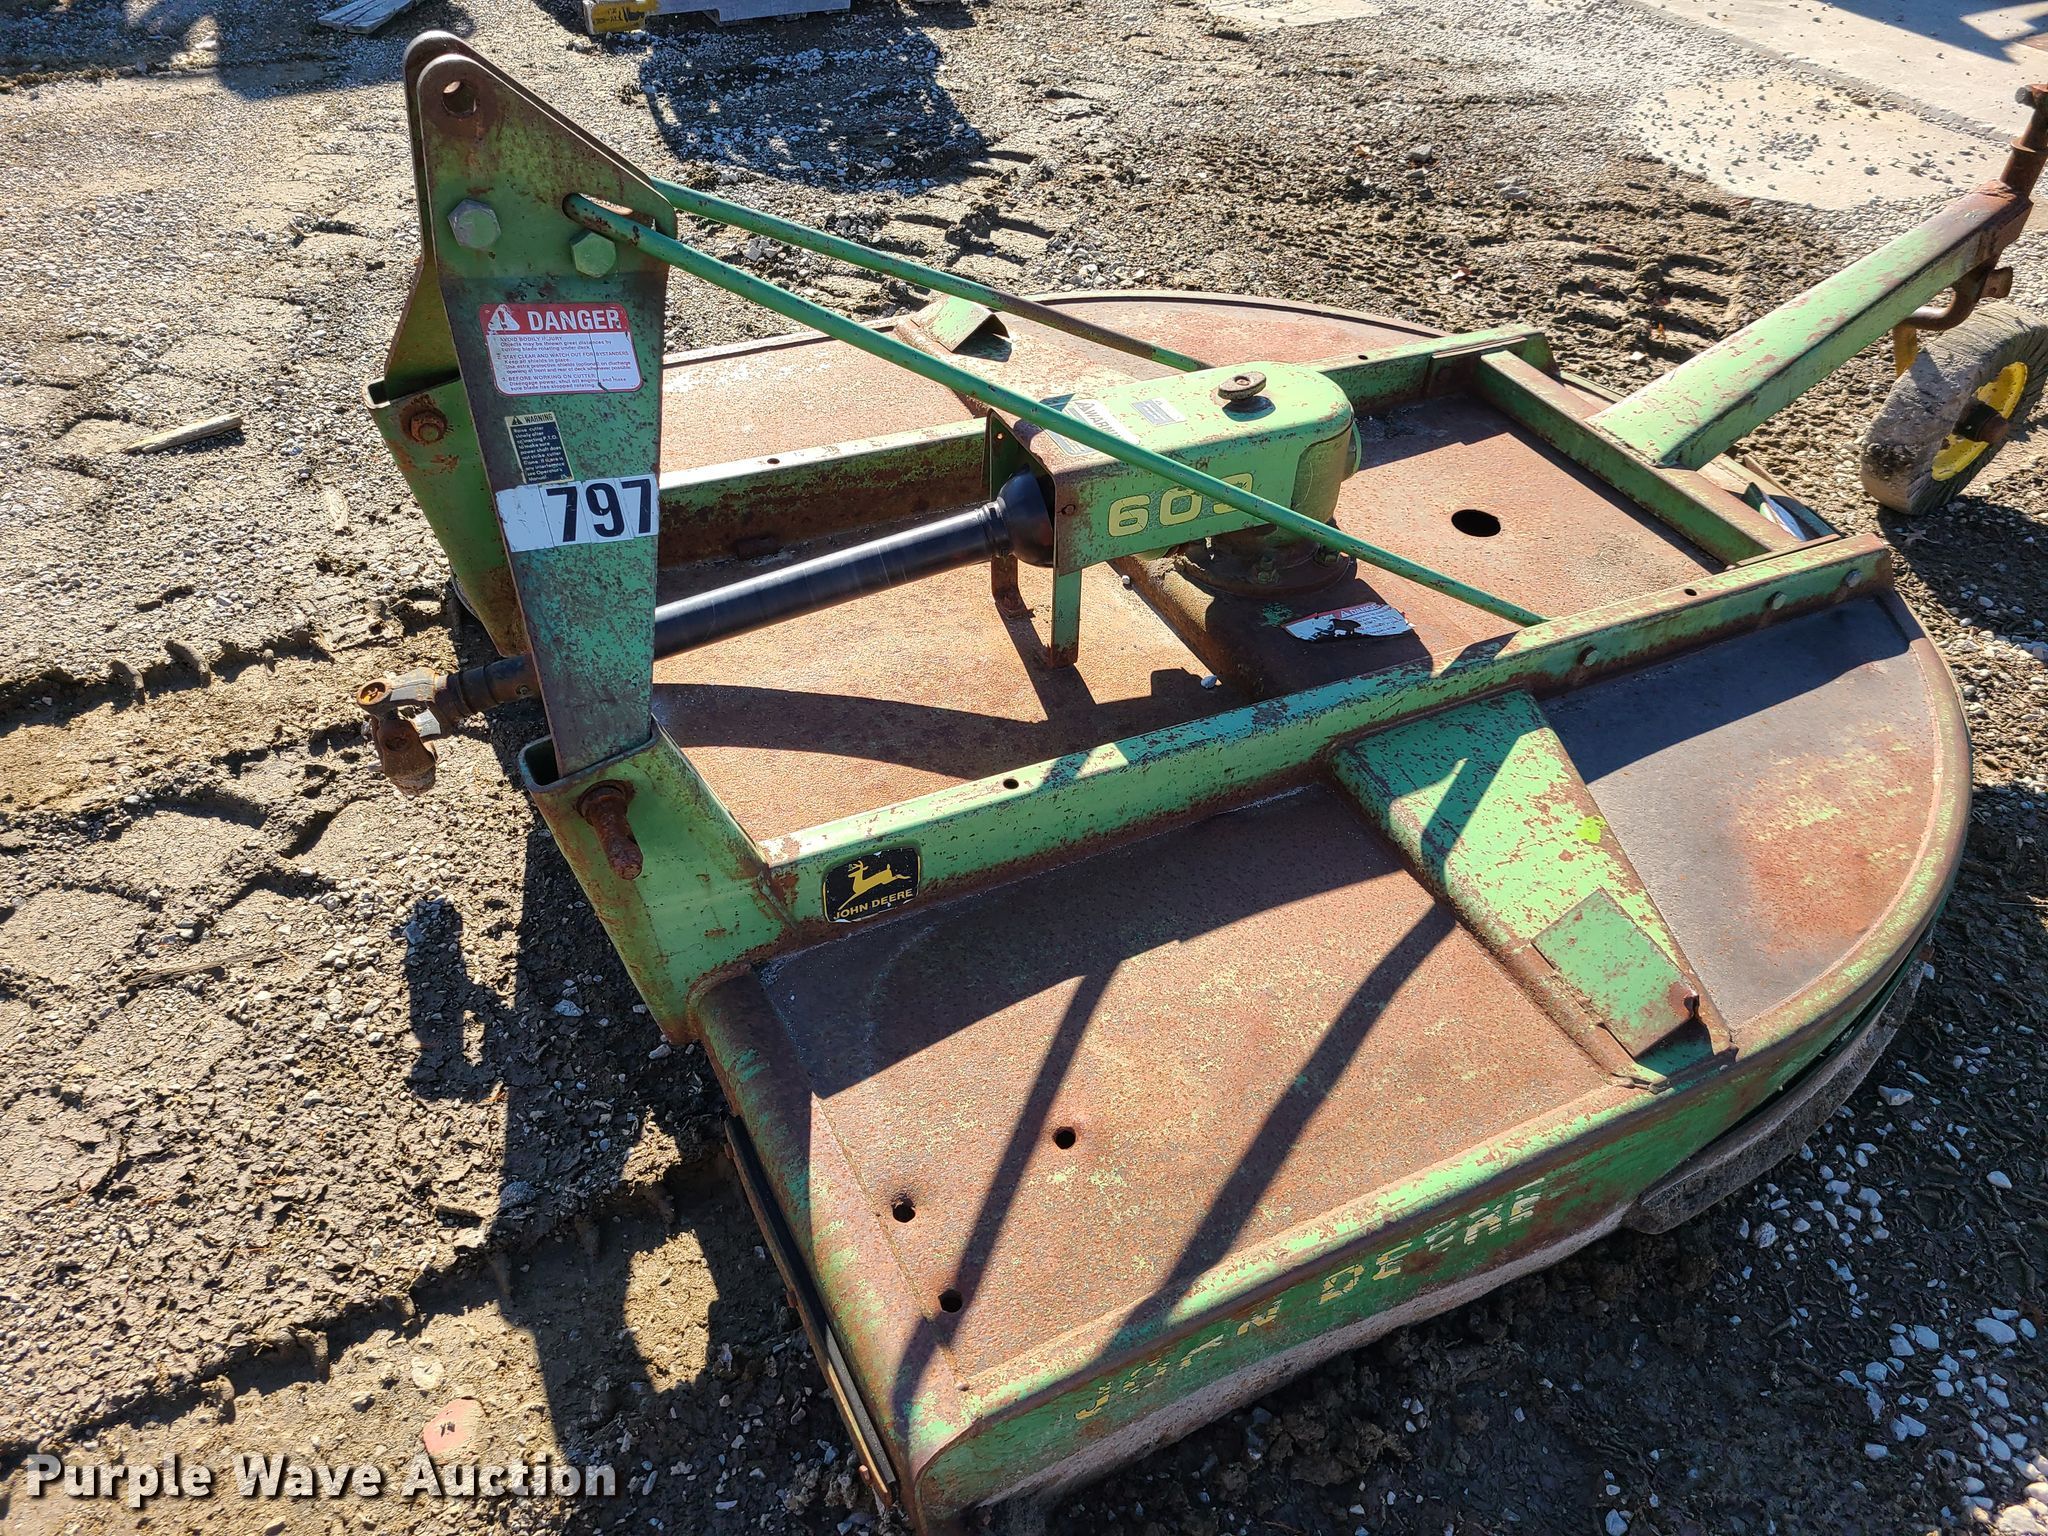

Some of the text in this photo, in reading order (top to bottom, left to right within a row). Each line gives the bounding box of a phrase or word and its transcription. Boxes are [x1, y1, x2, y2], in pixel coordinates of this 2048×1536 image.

[527, 309, 622, 331] DANGER
[524, 413, 554, 423] WARNING
[546, 478, 652, 542] 797
[833, 888, 913, 920] JOHN DEERE
